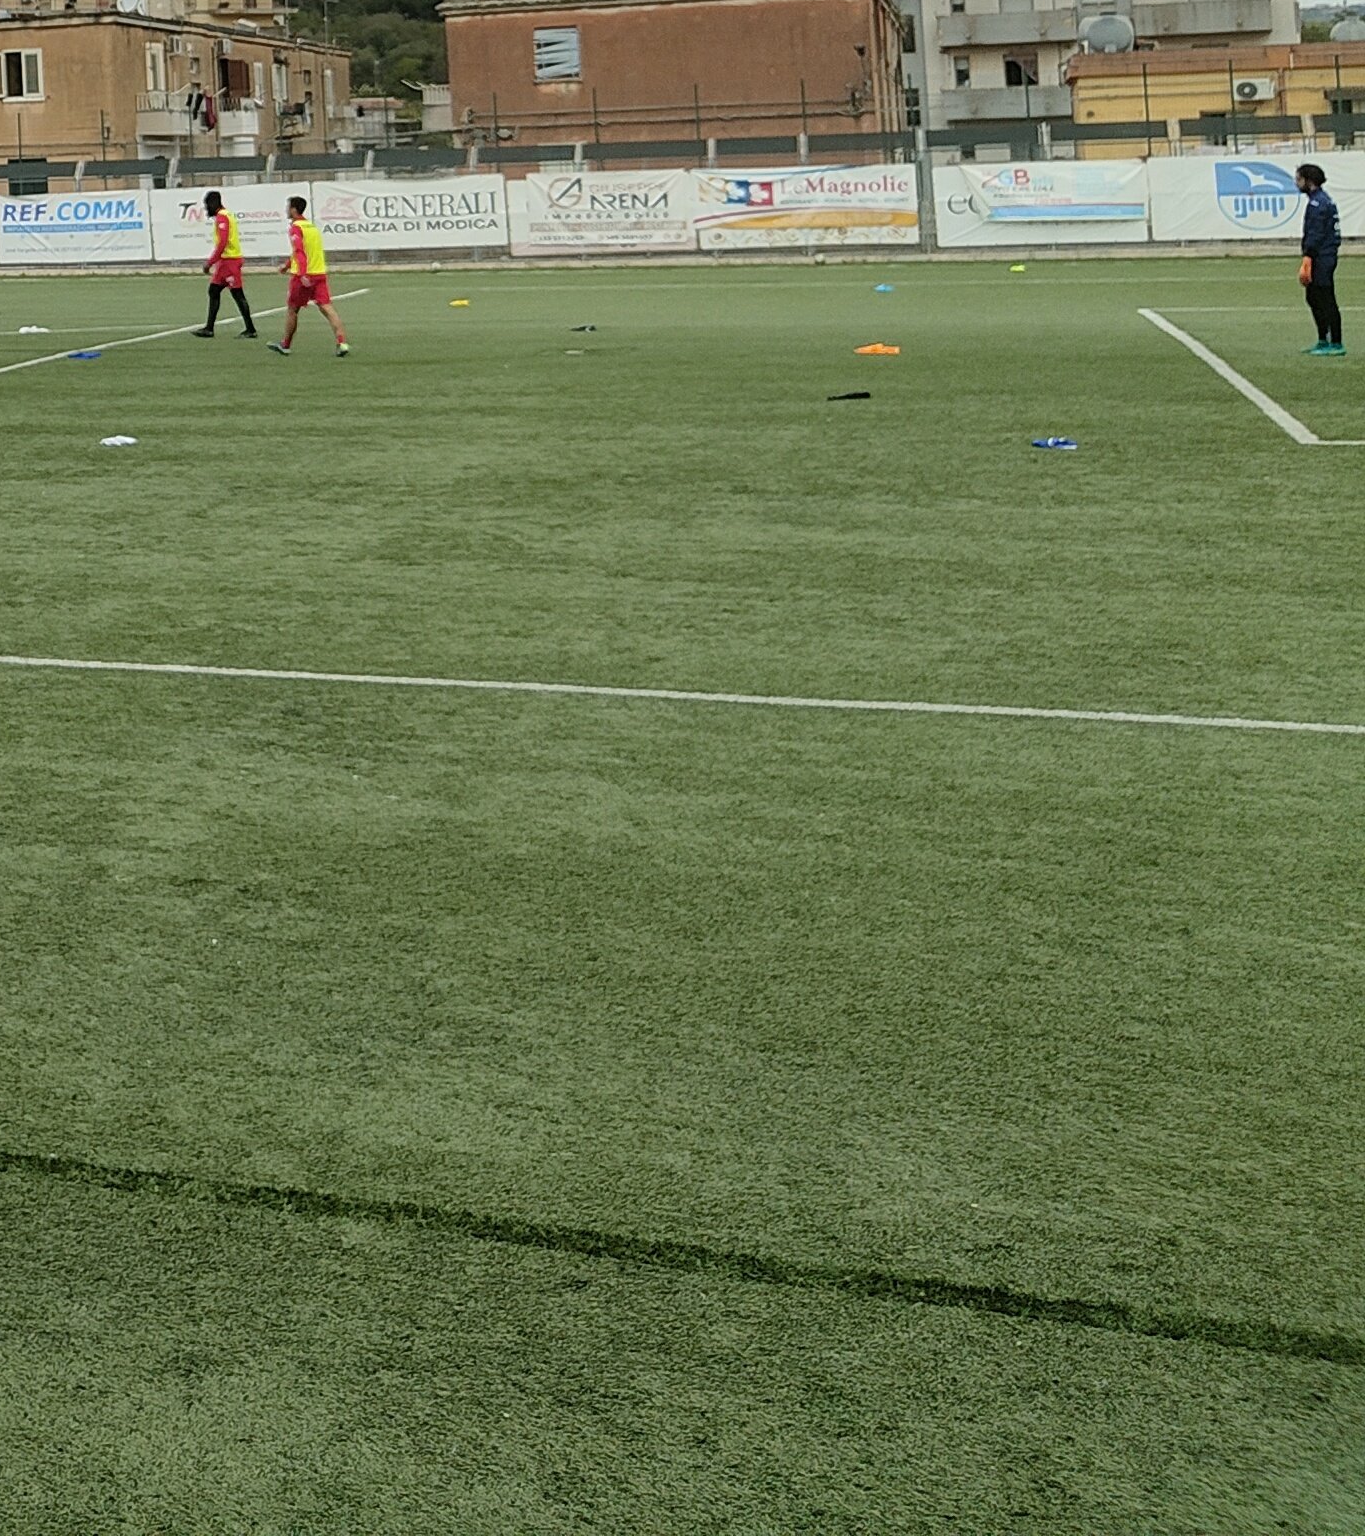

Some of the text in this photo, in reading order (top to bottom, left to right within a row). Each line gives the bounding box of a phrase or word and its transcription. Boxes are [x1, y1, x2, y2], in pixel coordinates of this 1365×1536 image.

[2, 199, 143, 222] REF.COMM.
[363, 191, 498, 219] GENERALI
[590, 191, 669, 211] ARENA
[323, 219, 499, 234] AGENZIA DI MODICA
